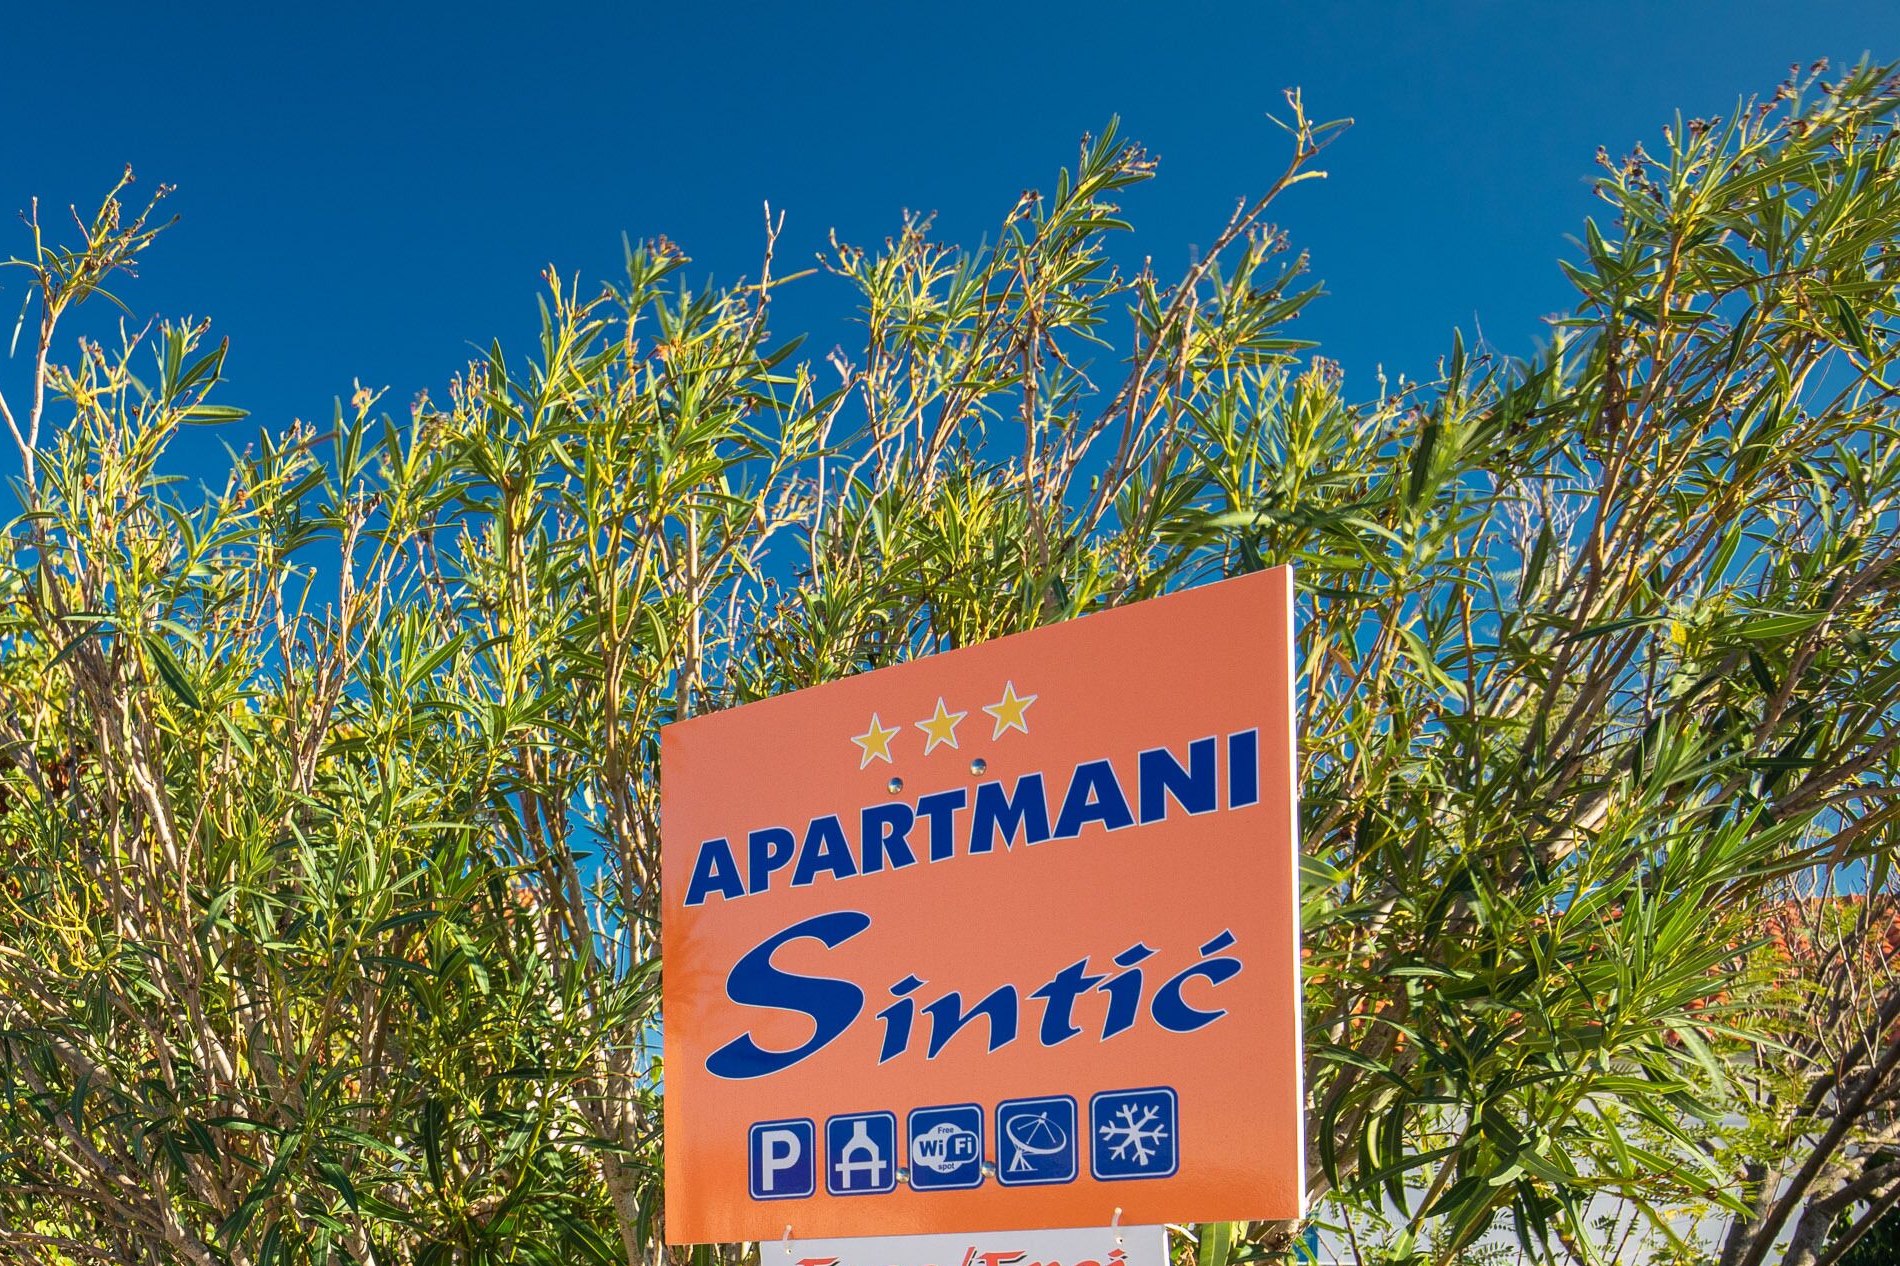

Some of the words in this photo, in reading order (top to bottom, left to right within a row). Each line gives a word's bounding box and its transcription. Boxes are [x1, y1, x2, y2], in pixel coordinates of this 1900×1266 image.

[683, 728, 1259, 907] APARTMANI
[704, 909, 1244, 1081] Sintić
[761, 1129, 801, 1191] P
[938, 1163, 955, 1171] spot
